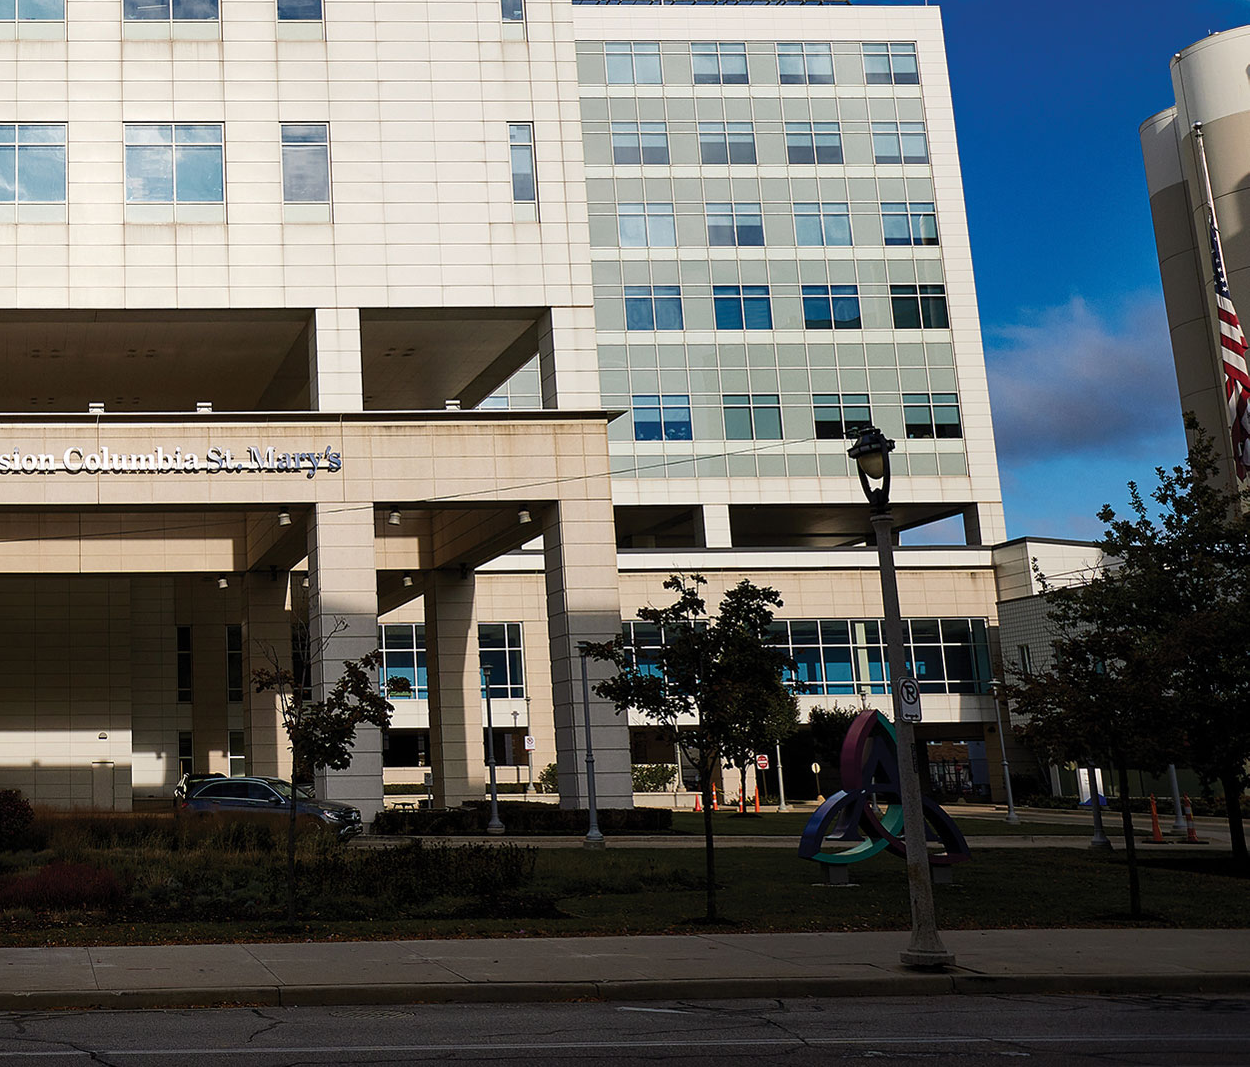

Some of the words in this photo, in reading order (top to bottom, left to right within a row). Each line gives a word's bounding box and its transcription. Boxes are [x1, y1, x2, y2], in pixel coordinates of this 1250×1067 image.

[63, 446, 200, 473] Columbia
[206, 446, 243, 473] St.
[248, 445, 342, 478] Mary's
